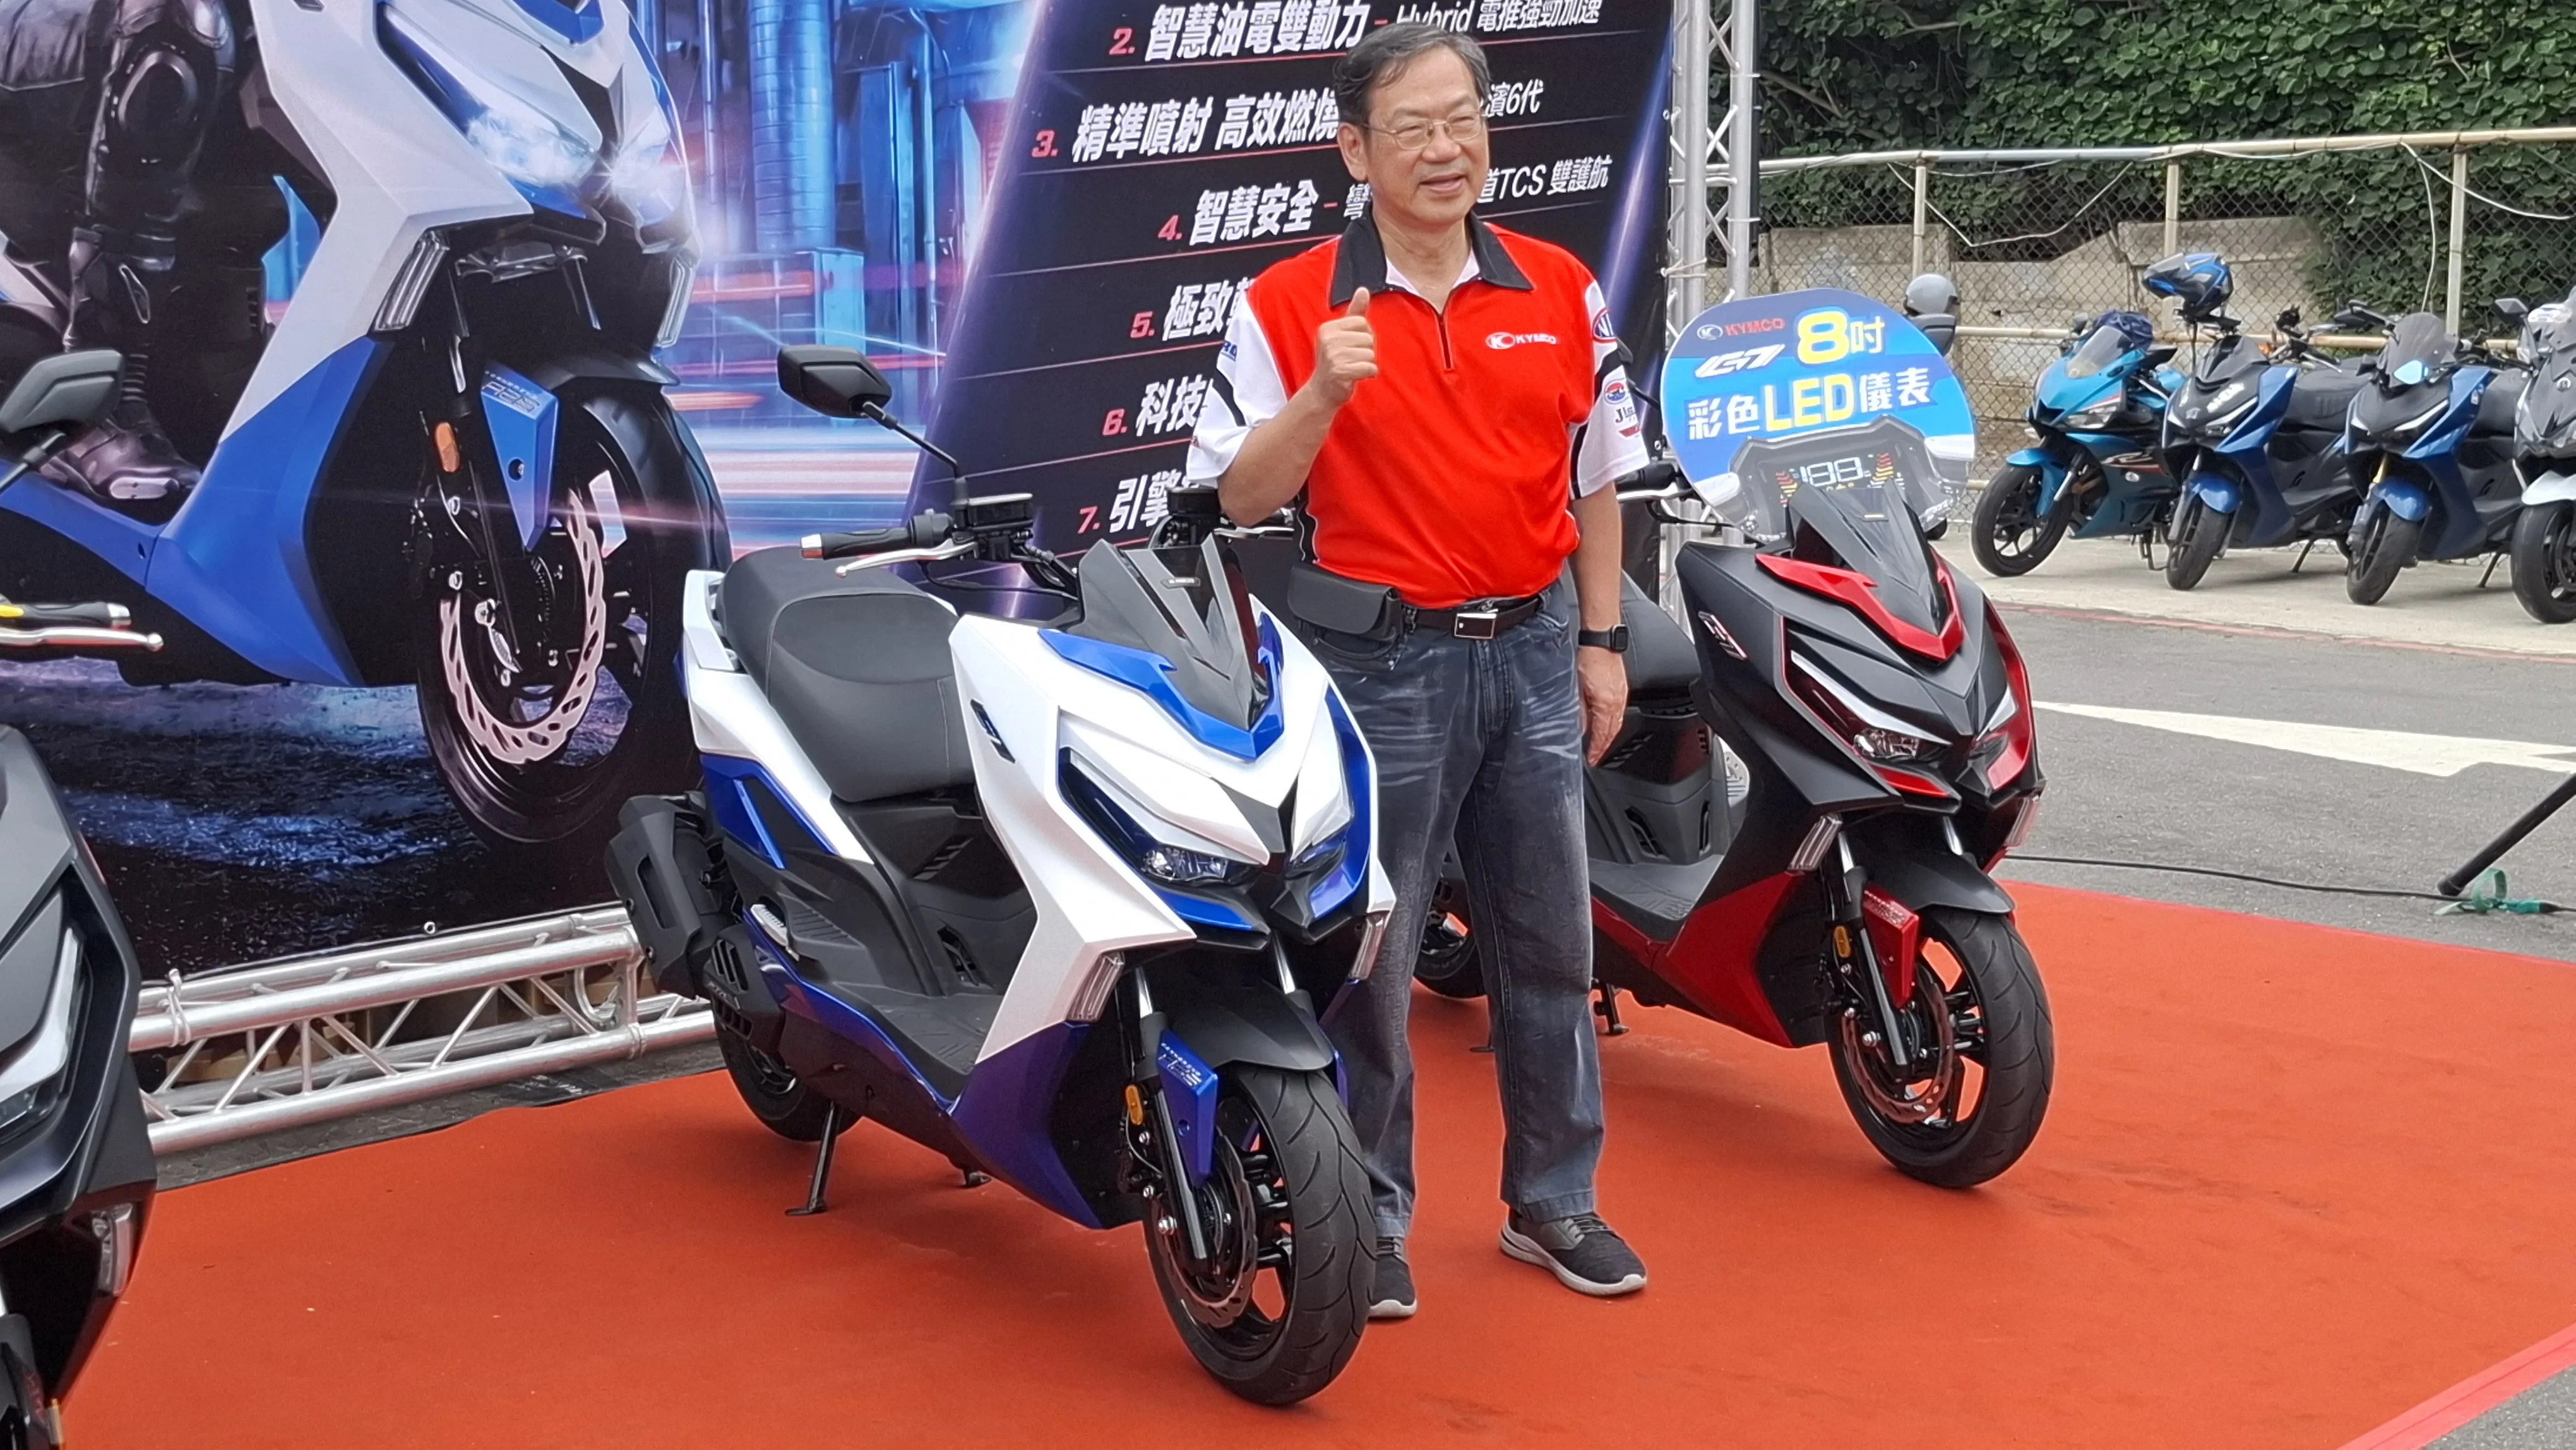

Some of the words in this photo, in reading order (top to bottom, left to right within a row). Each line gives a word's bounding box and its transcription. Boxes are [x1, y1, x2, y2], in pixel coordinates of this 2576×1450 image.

[1109, 28, 1136, 56] 2.
[1145, 0, 1371, 62] 智慧油電雙動力
[1477, 0, 1602, 32] 電推強勁加速
[1031, 130, 1059, 158] 3.
[1072, 96, 1213, 162] 精準噴射
[1214, 87, 1340, 150] 高效燃燒
[1480, 78, 1544, 117] 濱6代
[1157, 215, 1183, 241] 4.
[1189, 179, 1319, 246] 智慧安全
[1546, 155, 1613, 195] 雙護航
[1130, 311, 1155, 339] 5.
[1162, 276, 1254, 342] 極致
[1725, 318, 1786, 337] KYMCO
[1797, 309, 1885, 366] 8吋
[1102, 409, 1128, 436] 6.
[1136, 374, 1207, 437] 科技
[1688, 366, 1931, 441] 彩色LED儀表
[1077, 506, 1101, 534] 7.
[1109, 469, 1199, 533] 引擎
